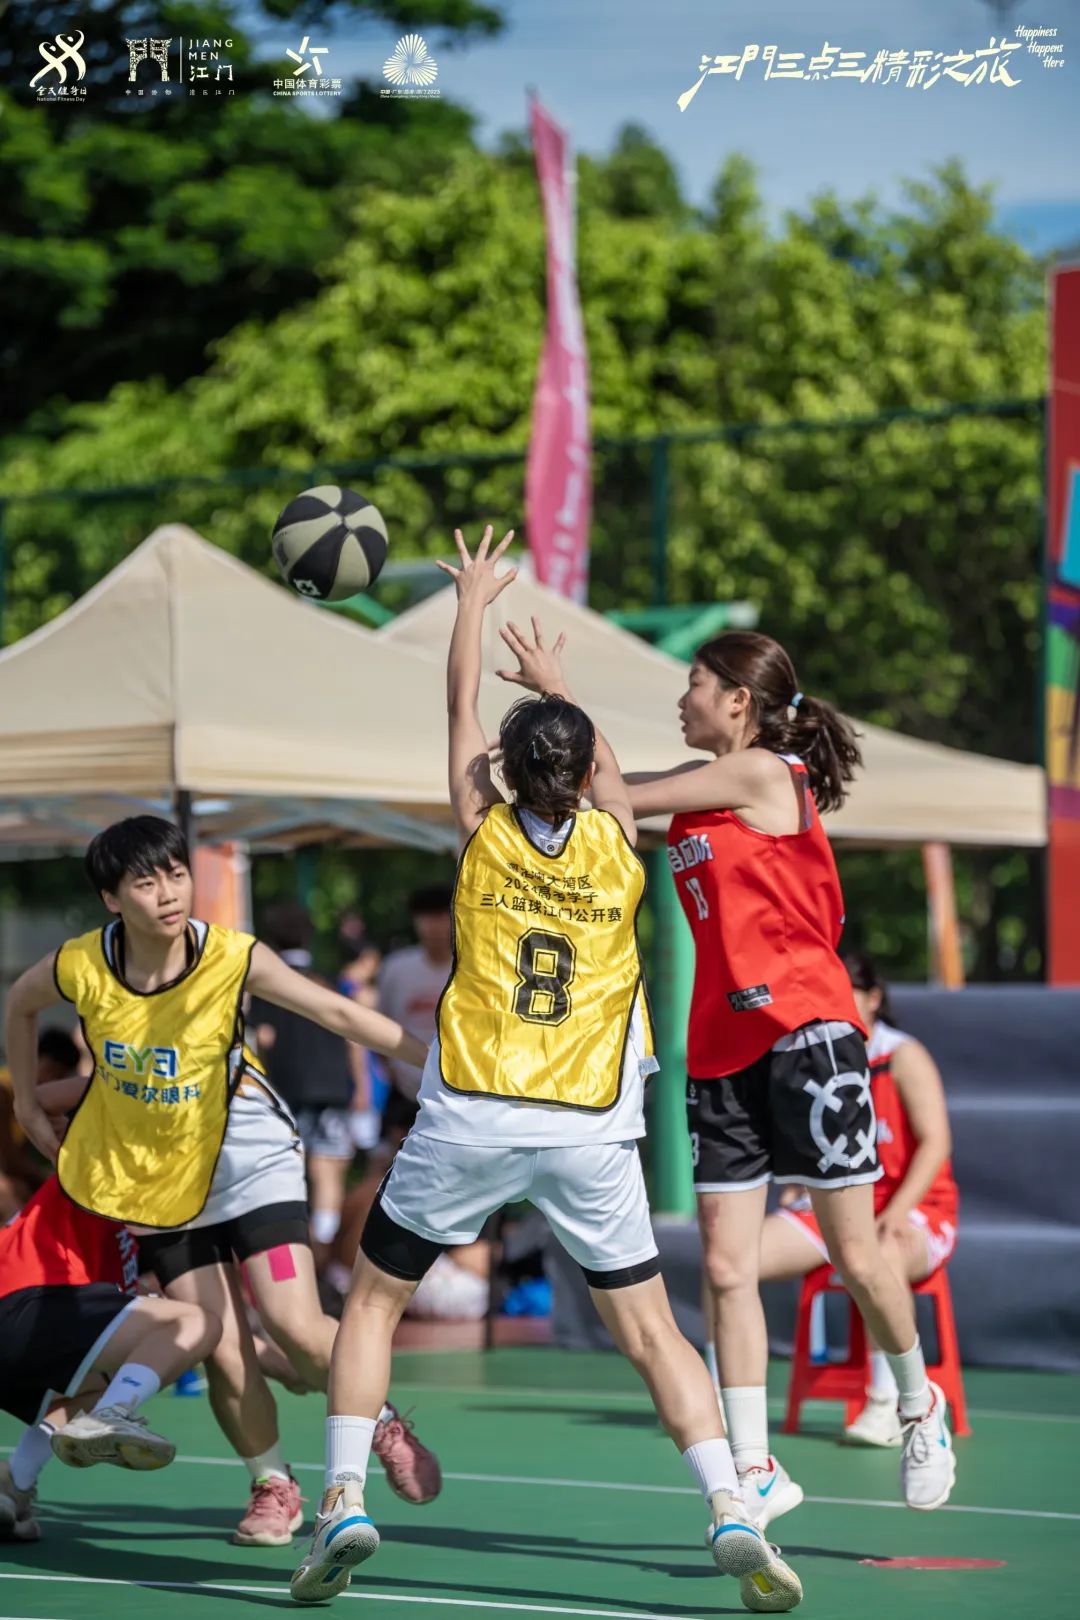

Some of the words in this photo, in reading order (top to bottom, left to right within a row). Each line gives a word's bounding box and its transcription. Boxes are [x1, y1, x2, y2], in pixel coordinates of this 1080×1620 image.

[480, 893, 622, 922] 三人篮球江门公开赛
[512, 927, 577, 1027] 8
